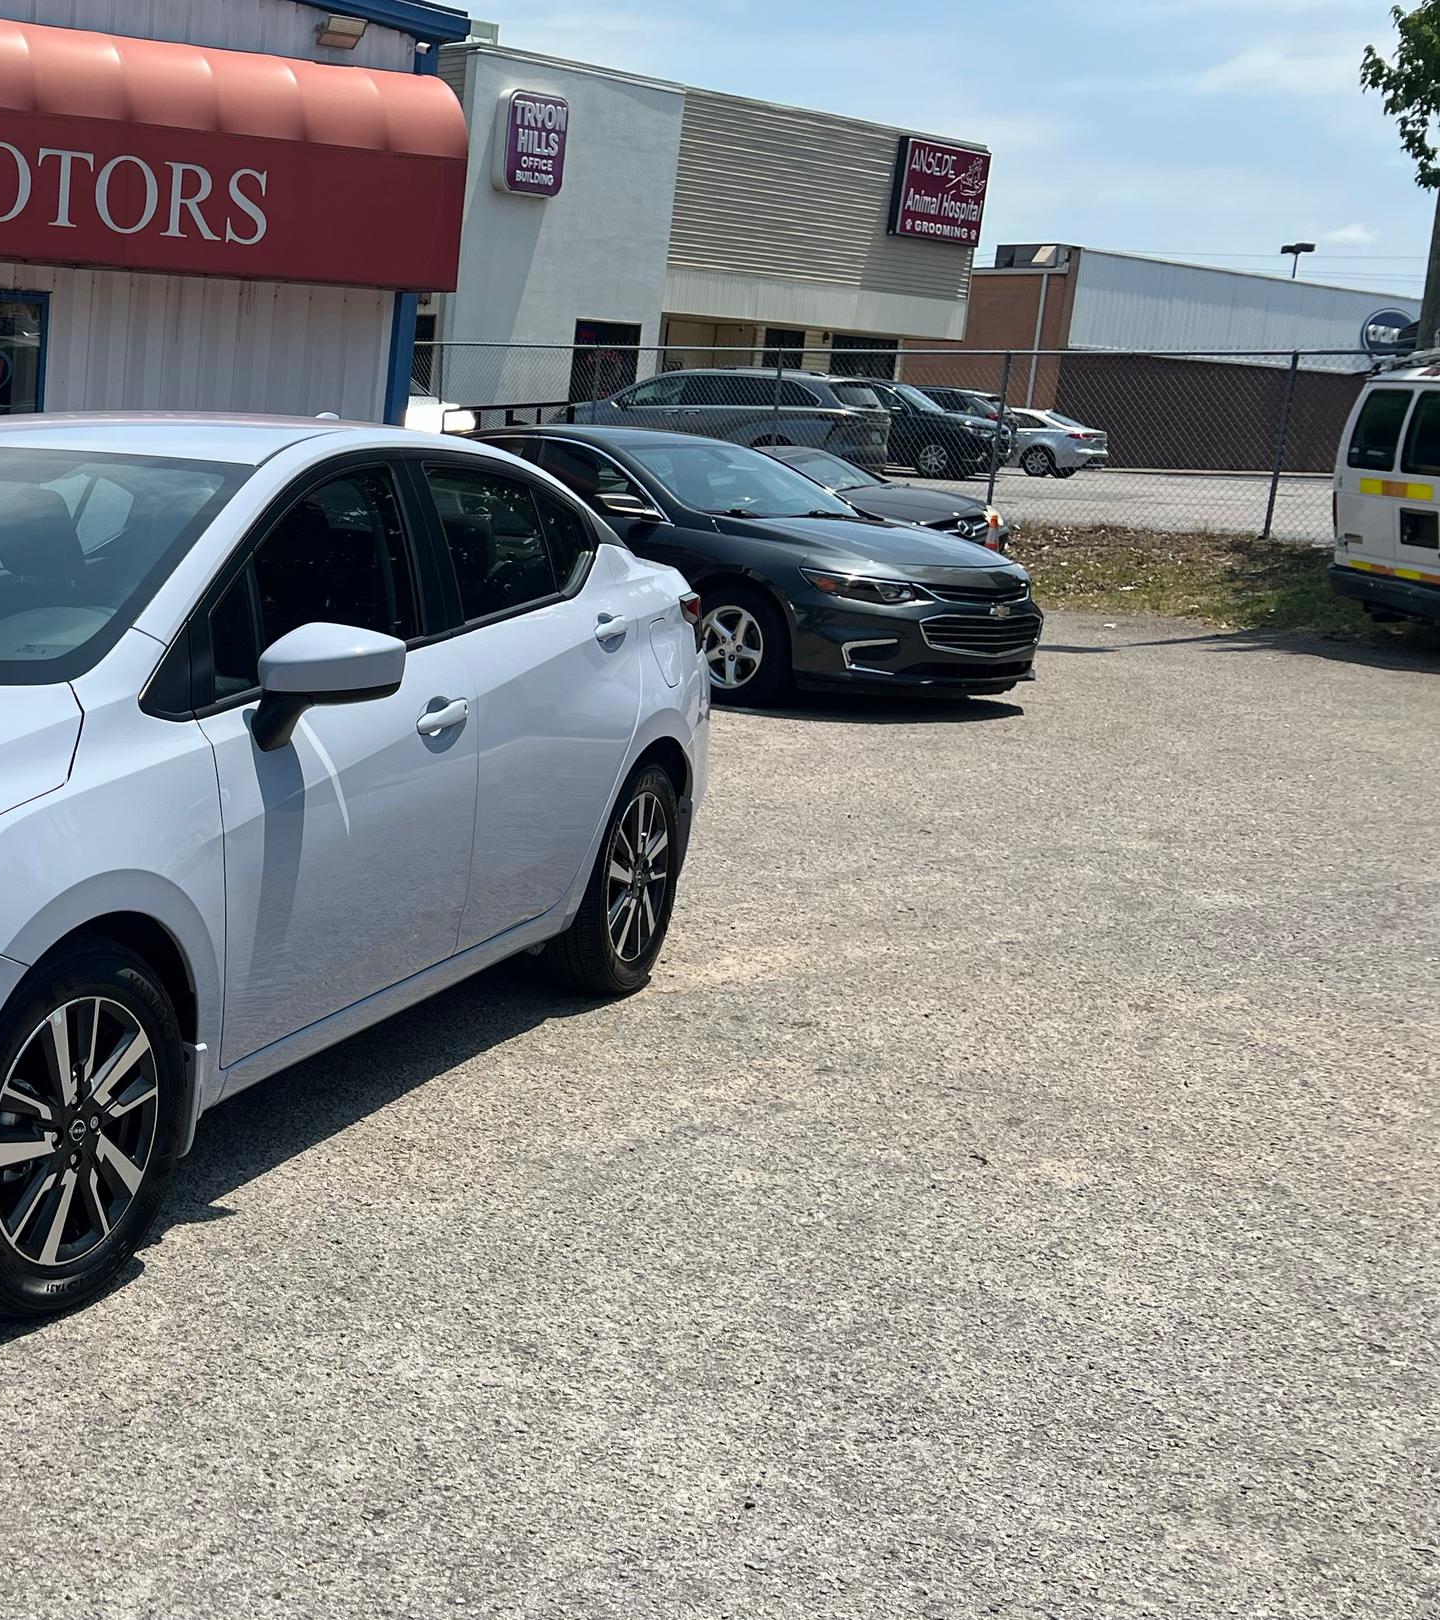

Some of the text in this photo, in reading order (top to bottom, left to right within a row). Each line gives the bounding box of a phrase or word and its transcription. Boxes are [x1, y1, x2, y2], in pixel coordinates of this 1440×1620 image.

[514, 99, 566, 131] TRYON
[517, 128, 559, 157] HILLS
[521, 156, 553, 171] OFFICE
[910, 147, 957, 179] ANSEDE
[515, 170, 554, 186] BUILDING
[905, 187, 983, 224] Animal Hospital
[914, 220, 968, 239] GROOMING
